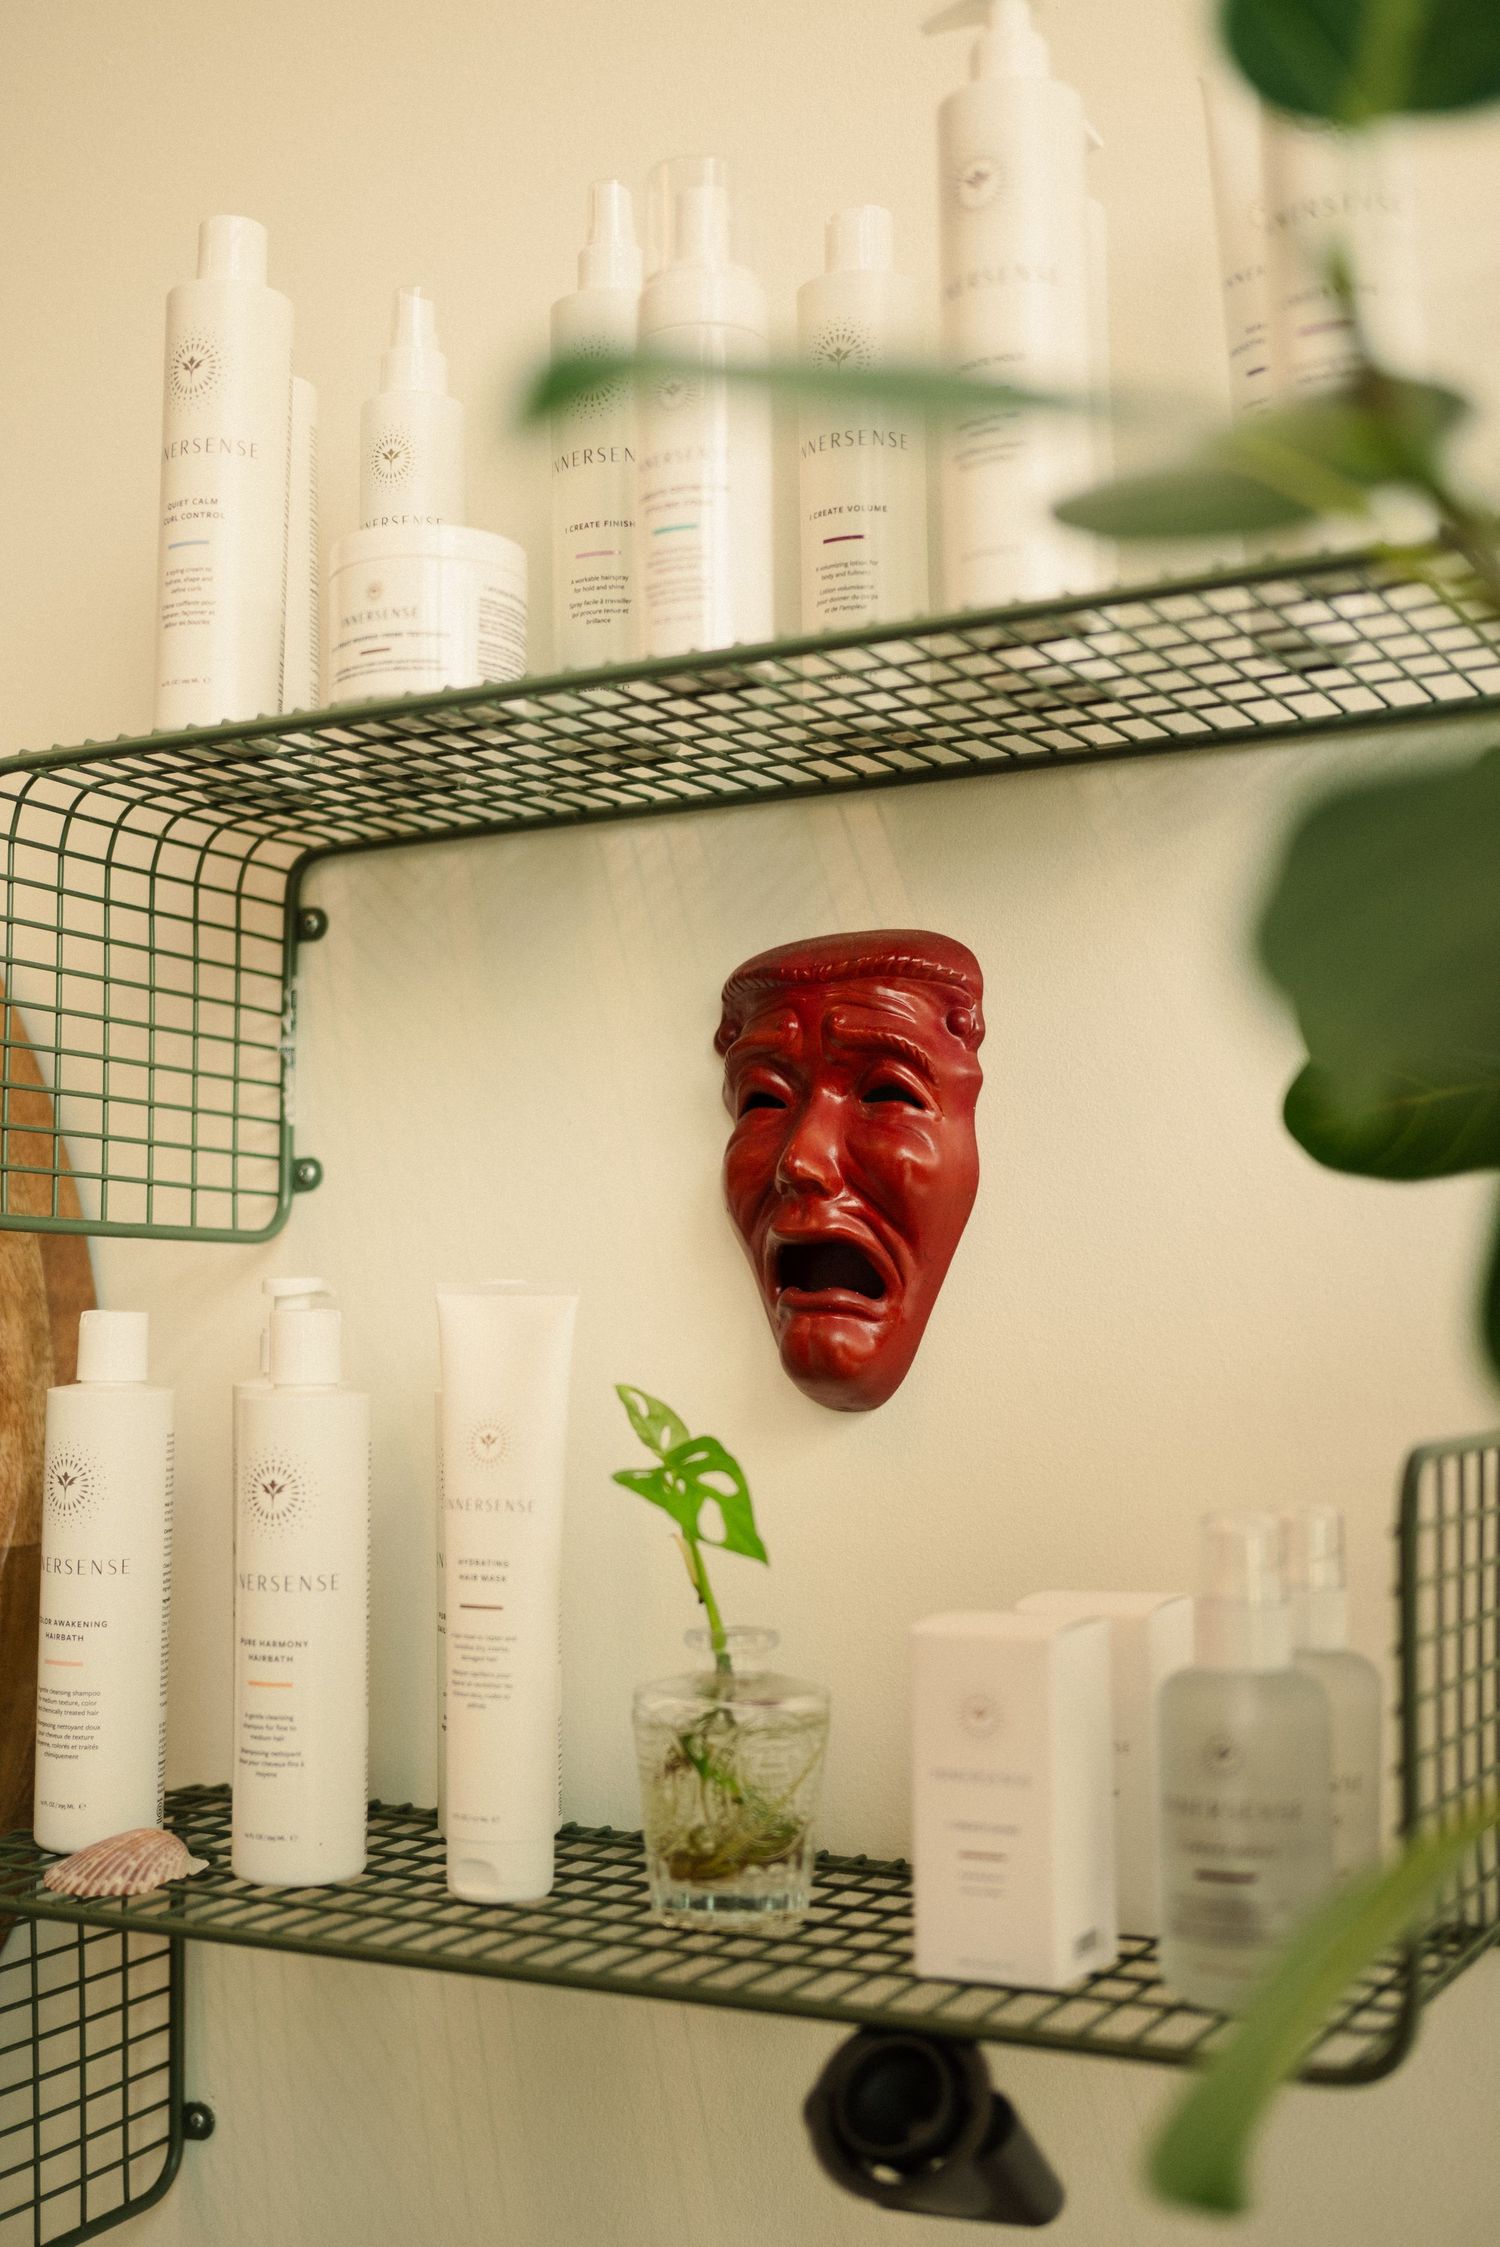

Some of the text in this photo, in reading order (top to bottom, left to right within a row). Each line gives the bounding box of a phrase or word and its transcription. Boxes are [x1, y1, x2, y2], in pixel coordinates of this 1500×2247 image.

[163, 437, 260, 461] NERSENSE
[801, 429, 909, 460] NNERSENSE
[552, 447, 636, 476] INNERSEN
[167, 499, 188, 511] QUIET
[181, 511, 226, 520] CONTROL
[813, 506, 843, 520] CREATE
[847, 504, 888, 512] VOLUME
[569, 521, 600, 533] CREATE
[447, 1498, 535, 1512] NNERSENSE
[41, 1555, 131, 1575] NERSENSE
[239, 1573, 341, 1592] NERSENSE
[53, 1619, 108, 1628] AWAKENING
[45, 1631, 84, 1642] HAIRBATH
[240, 1637, 309, 1648] PURE HARMONY
[248, 1654, 294, 1663] HAIRBATH
[58, 1699, 80, 1707] texture,
[57, 1723, 85, 1732] nettoyant
[85, 1723, 101, 1731] doux
